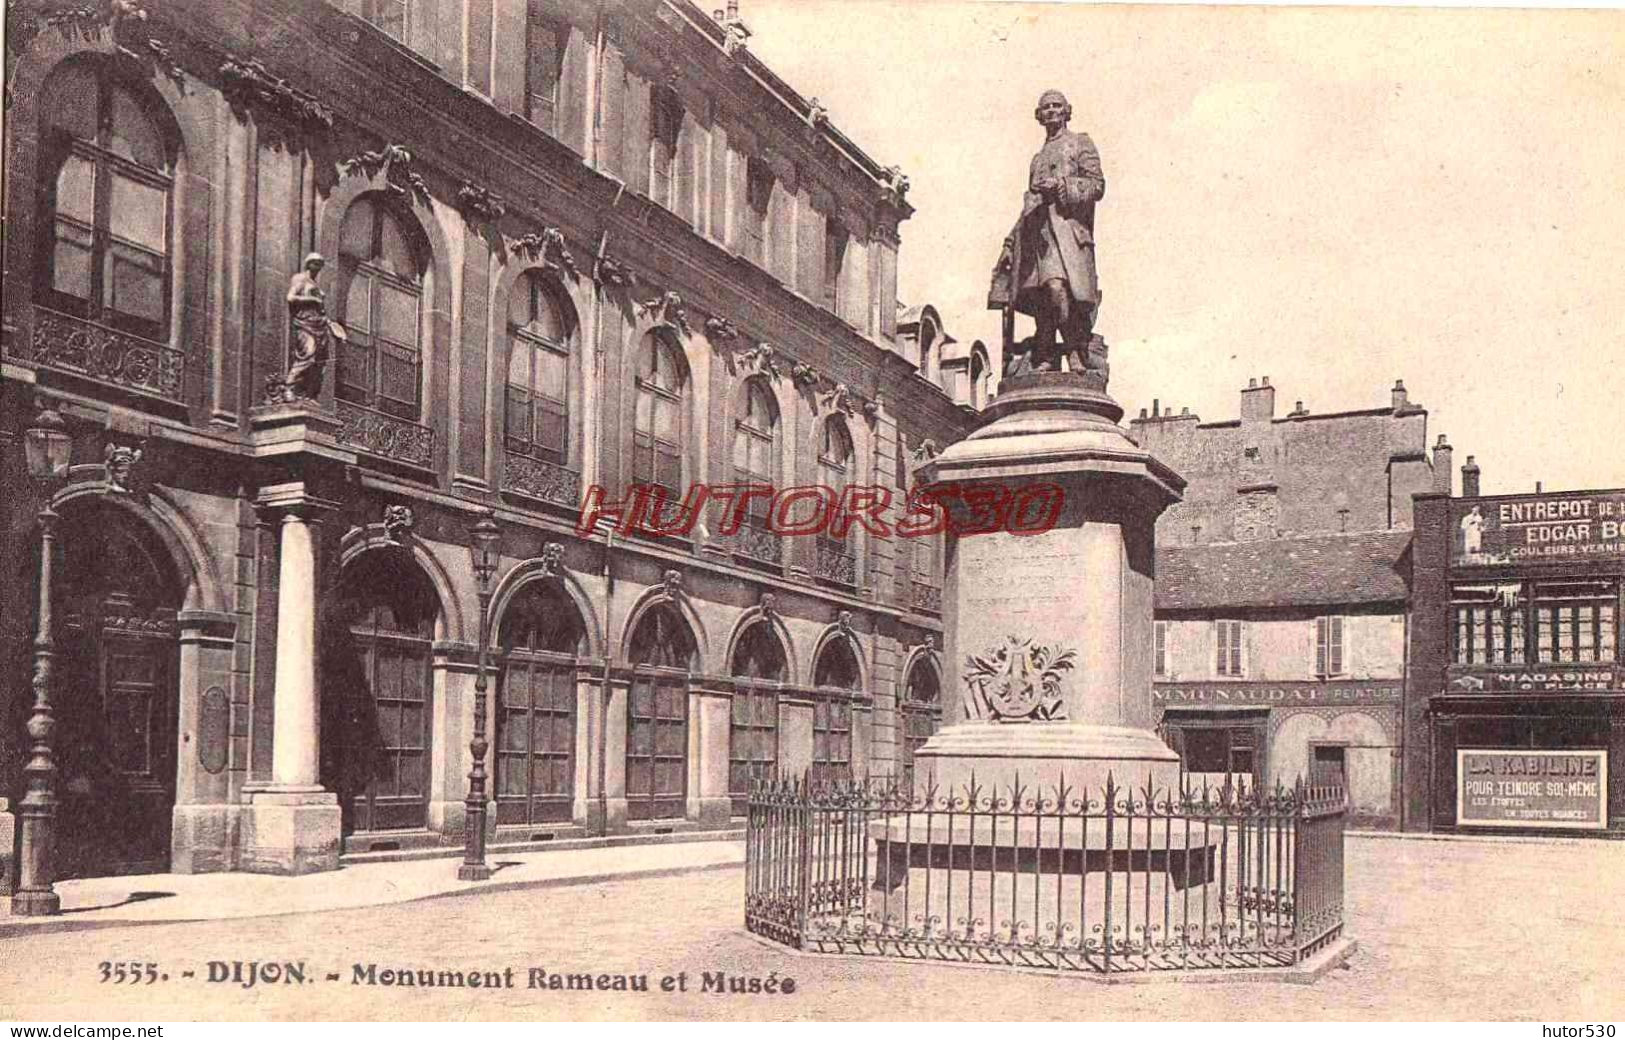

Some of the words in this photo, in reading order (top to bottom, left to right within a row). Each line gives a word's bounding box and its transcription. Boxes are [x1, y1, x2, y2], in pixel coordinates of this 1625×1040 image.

[1500, 500, 1591, 520] ENTREPOT
[1599, 502, 1613, 516] DE
[1526, 524, 1590, 542] EDGAR
[1499, 672, 1612, 683] MAGASINS
[1545, 682, 1607, 690] PLACE
[1470, 757, 1495, 775] LA
[1501, 757, 1597, 777] KABILINE
[1466, 781, 1494, 796] POUR
[1498, 781, 1543, 797] TEINDRE
[1472, 797, 1488, 806] LES
